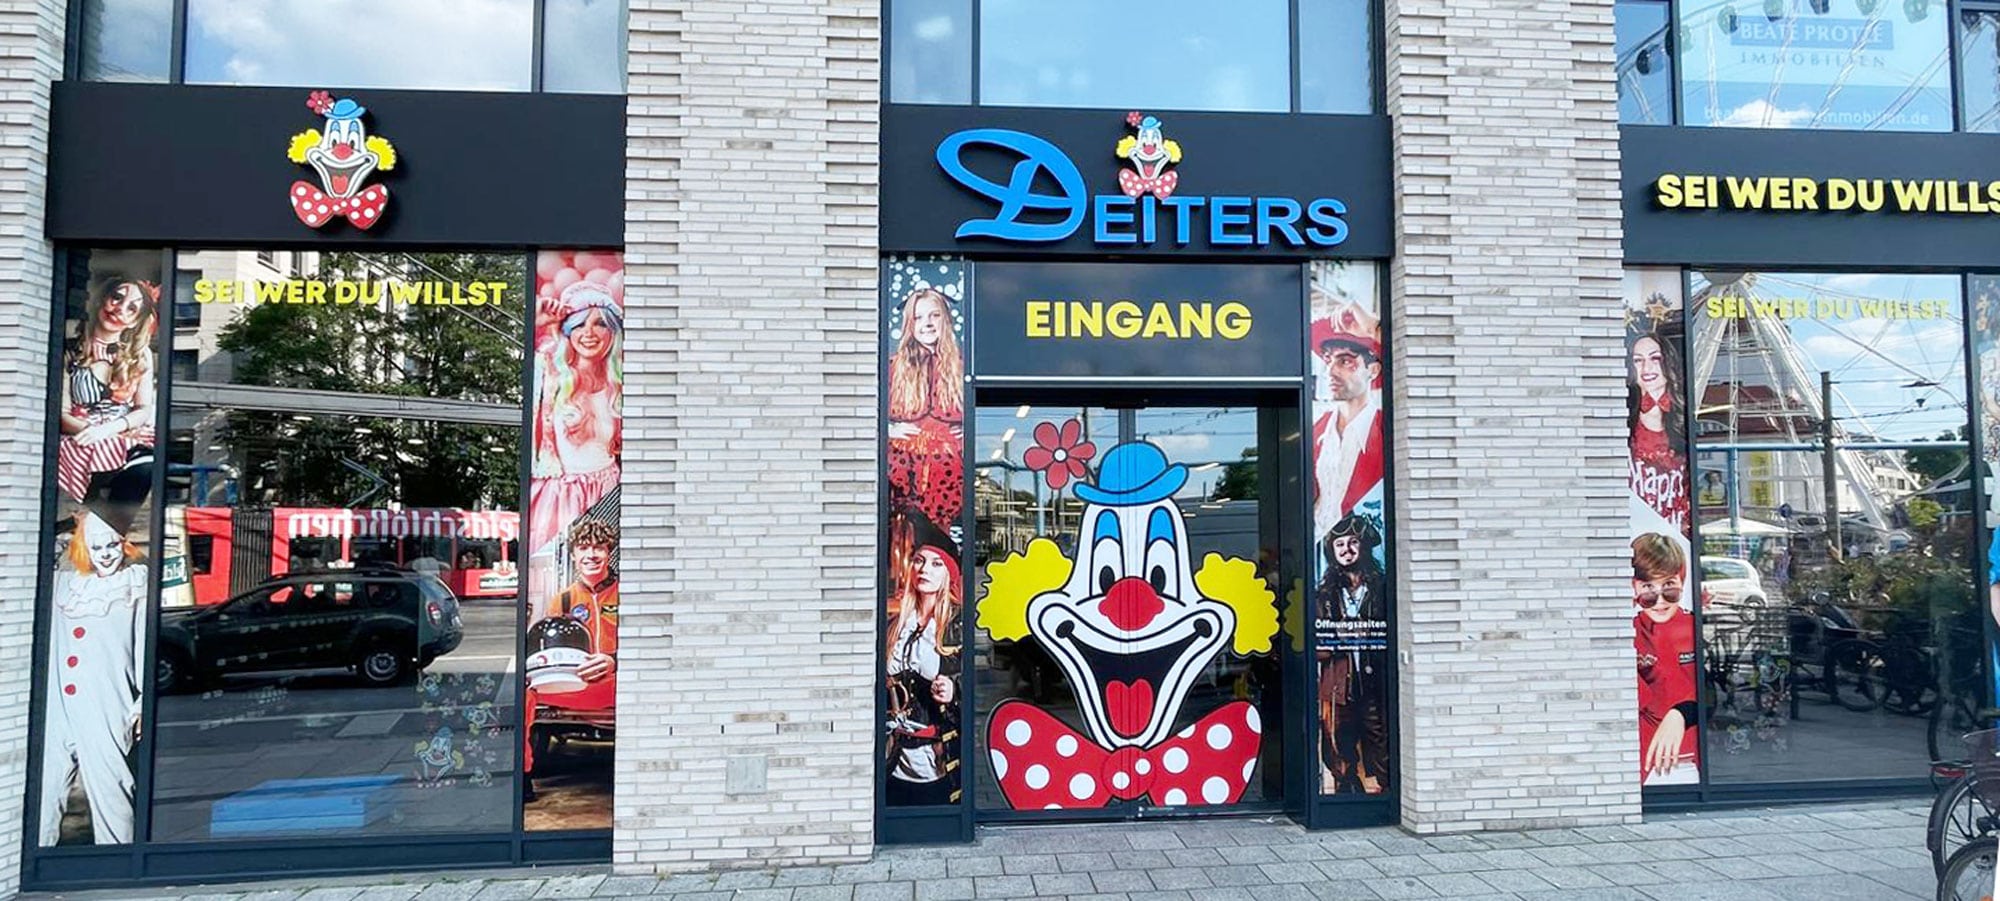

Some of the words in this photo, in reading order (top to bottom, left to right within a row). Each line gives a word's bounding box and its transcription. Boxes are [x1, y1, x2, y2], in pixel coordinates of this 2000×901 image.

[1741, 23, 1799, 41] BEATE
[1657, 174, 1718, 207] SEI
[1725, 176, 1819, 210] WER
[1827, 178, 1884, 212] DU
[194, 280, 244, 303] SEI
[254, 281, 326, 304] WER
[335, 282, 382, 304] DU
[390, 282, 507, 305] WILLST
[1025, 300, 1252, 339] EINGANG
[1707, 297, 1745, 319] SEI
[1752, 298, 1811, 320] WER
[1816, 299, 1850, 320] DU
[1859, 299, 1953, 321] WILLST
